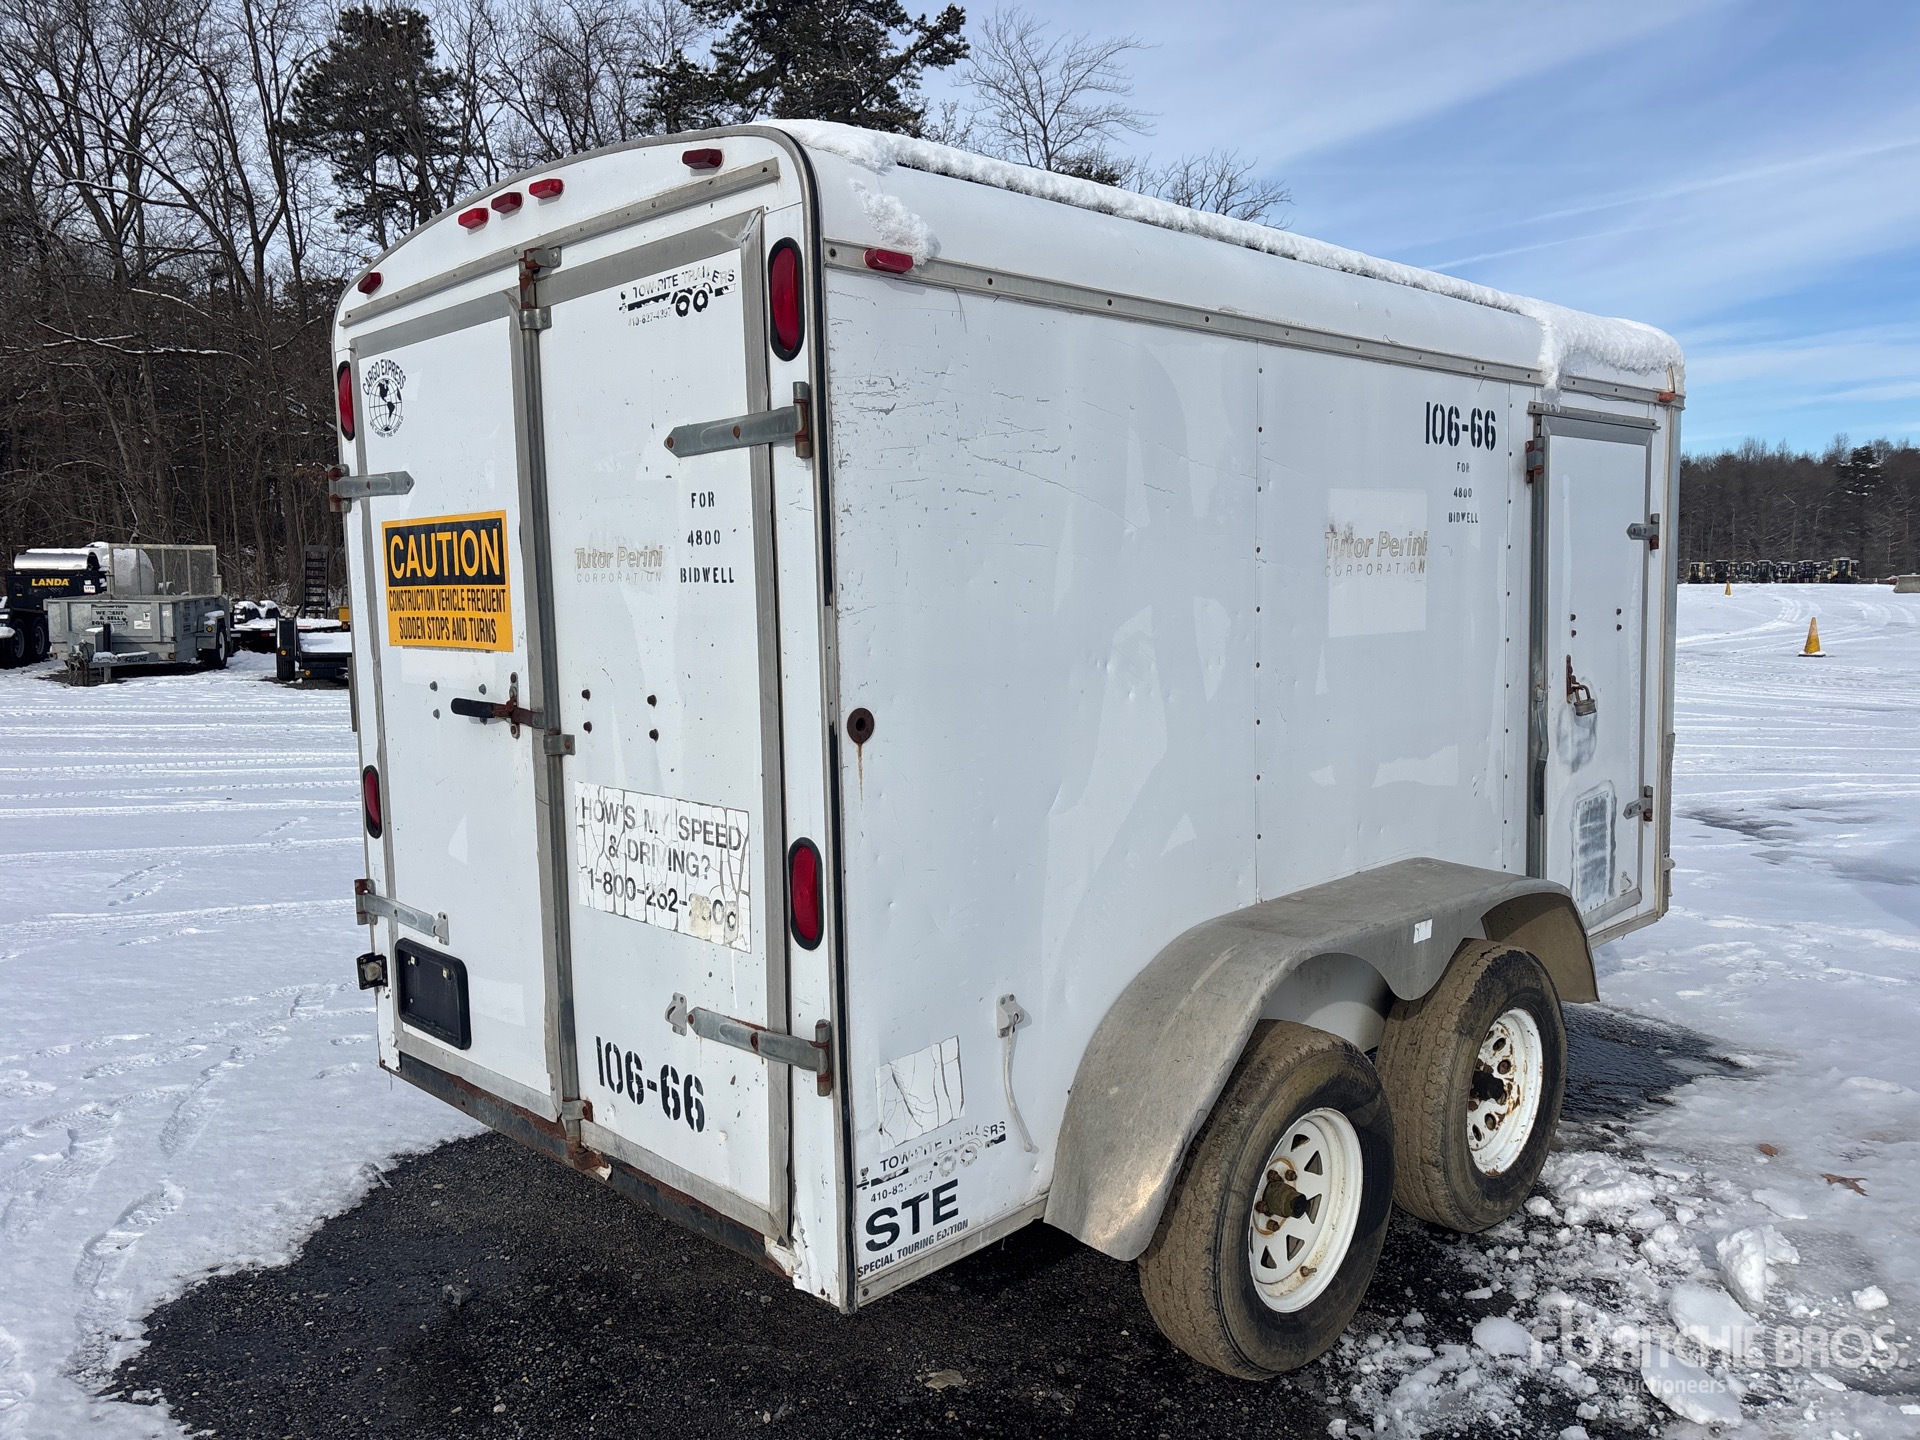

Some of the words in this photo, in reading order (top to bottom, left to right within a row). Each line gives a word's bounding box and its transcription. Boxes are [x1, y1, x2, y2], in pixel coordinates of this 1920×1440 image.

[362, 361, 380, 395] CARGO
[380, 358, 407, 389] EXPRESS
[1425, 401, 1496, 451] 106-66
[1456, 461, 1470, 473] FOR
[690, 491, 715, 508] FOR
[1453, 486, 1472, 499] 4800
[1448, 511, 1478, 523] BIDWELL
[687, 529, 721, 547] 4800
[390, 528, 500, 579] CAUTION
[575, 547, 613, 569] Tutor
[617, 545, 663, 568] Perini
[31, 578, 69, 587] LANDA
[576, 571, 661, 583] CORPORATION
[680, 566, 735, 583] BIDWELL
[389, 588, 436, 612] CONSTRUCTION
[437, 588, 465, 612] VEHICLE
[467, 588, 506, 613] FREQUENT
[399, 616, 426, 640] SUDDEN
[427, 616, 450, 641] STOPS
[452, 617, 467, 641] AND
[468, 617, 497, 644] TURNS
[679, 815, 742, 851] SPEED
[608, 834, 620, 859] &
[596, 1035, 705, 1133] 106-66
[865, 1178, 959, 1252] STE
[857, 1253, 895, 1277] SPECIAL
[897, 1234, 935, 1259] TOURING
[936, 1219, 969, 1241] EDITION
